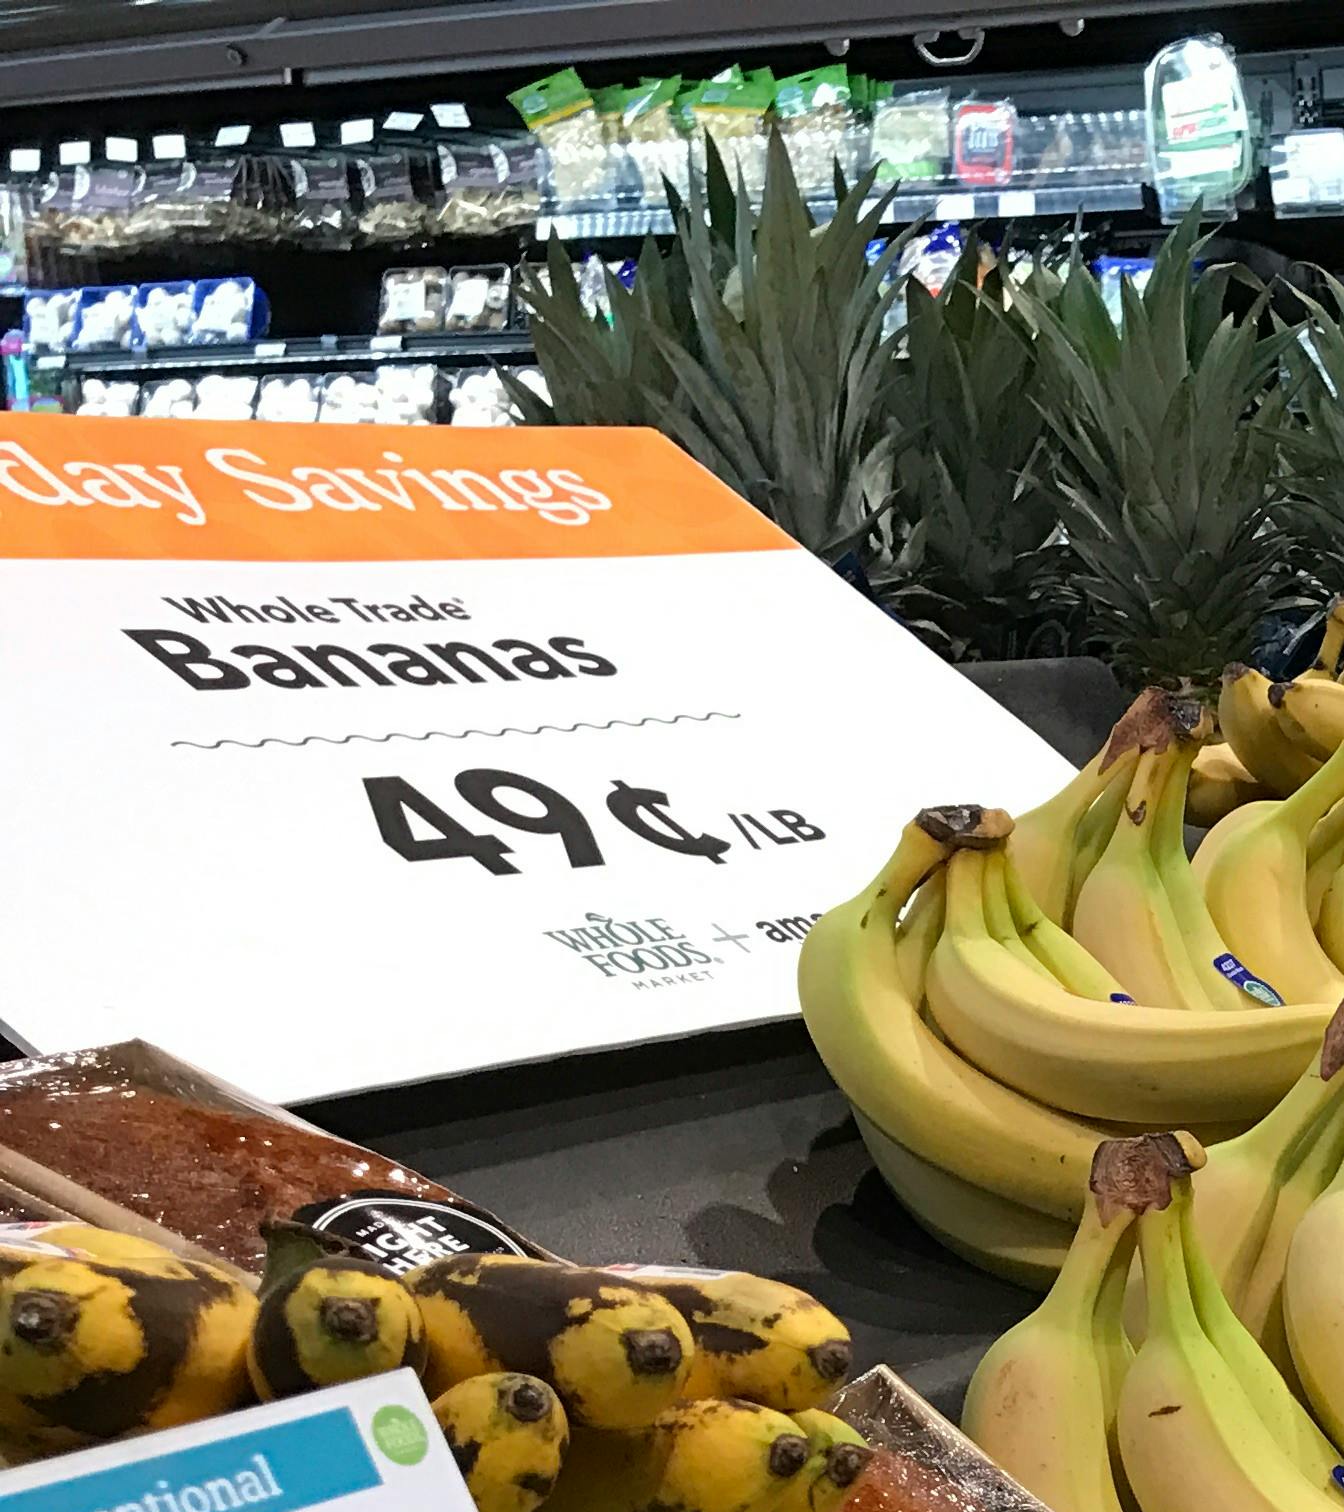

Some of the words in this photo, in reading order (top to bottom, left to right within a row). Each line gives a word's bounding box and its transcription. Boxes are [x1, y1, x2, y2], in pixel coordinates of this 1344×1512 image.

[203, 447, 612, 526] Savings
[160, 594, 348, 624] Whole
[120, 627, 619, 691] Bananas
[542, 911, 690, 956] WHOLE
[580, 942, 716, 979] FOODS
[631, 969, 716, 992] MARKET
[361, 1215, 448, 1259] IGHT
